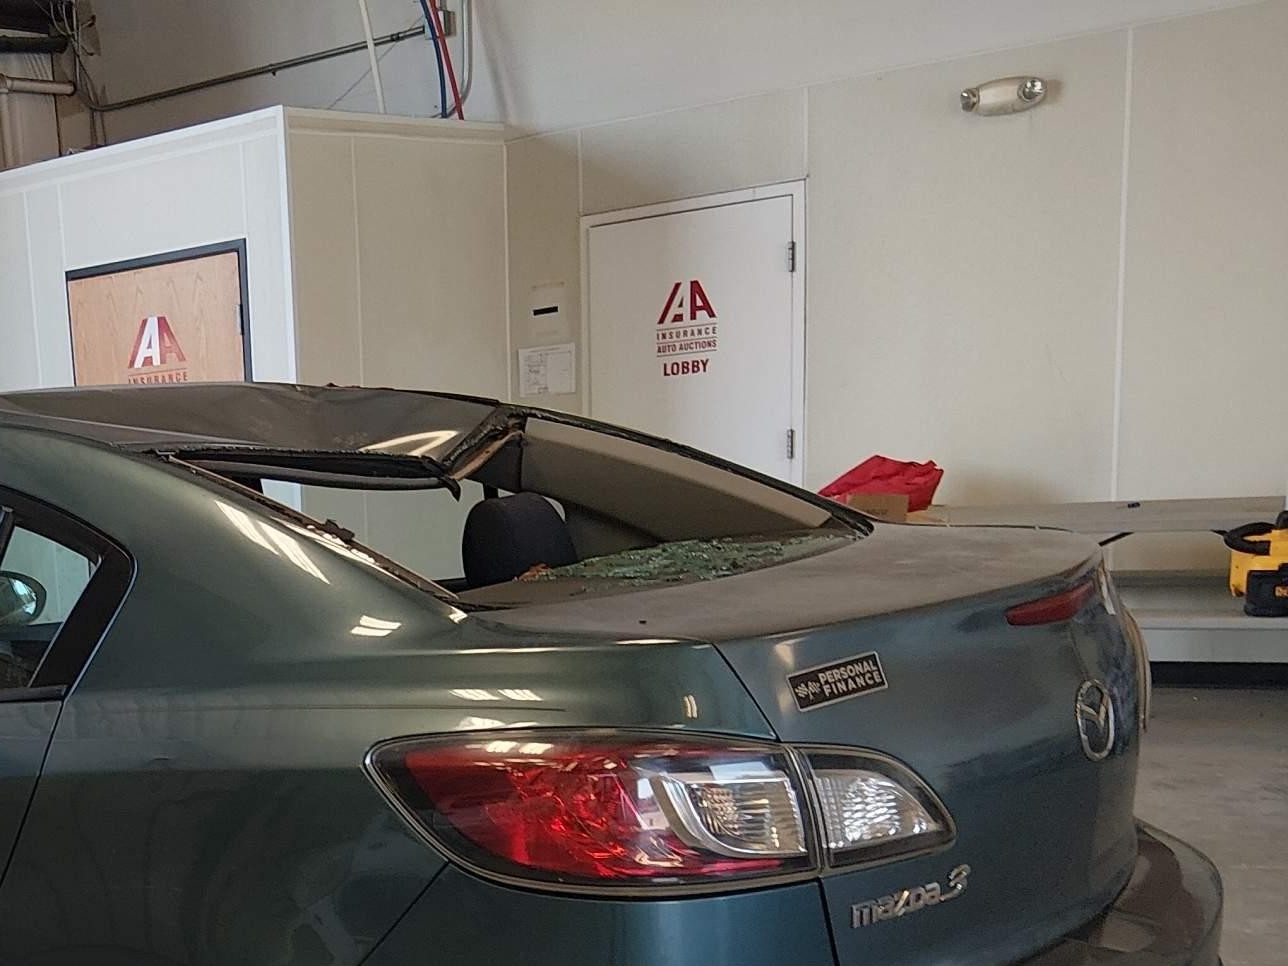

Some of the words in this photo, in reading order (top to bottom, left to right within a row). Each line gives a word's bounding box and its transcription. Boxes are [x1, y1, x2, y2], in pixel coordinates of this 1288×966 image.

[656, 326, 718, 341] INSURANCE
[657, 343, 677, 354] AUTO
[678, 339, 717, 352] AUCTIONS
[663, 358, 710, 377] LOBBY
[818, 659, 877, 685] PERSONAL
[822, 670, 882, 697] FINANCE
